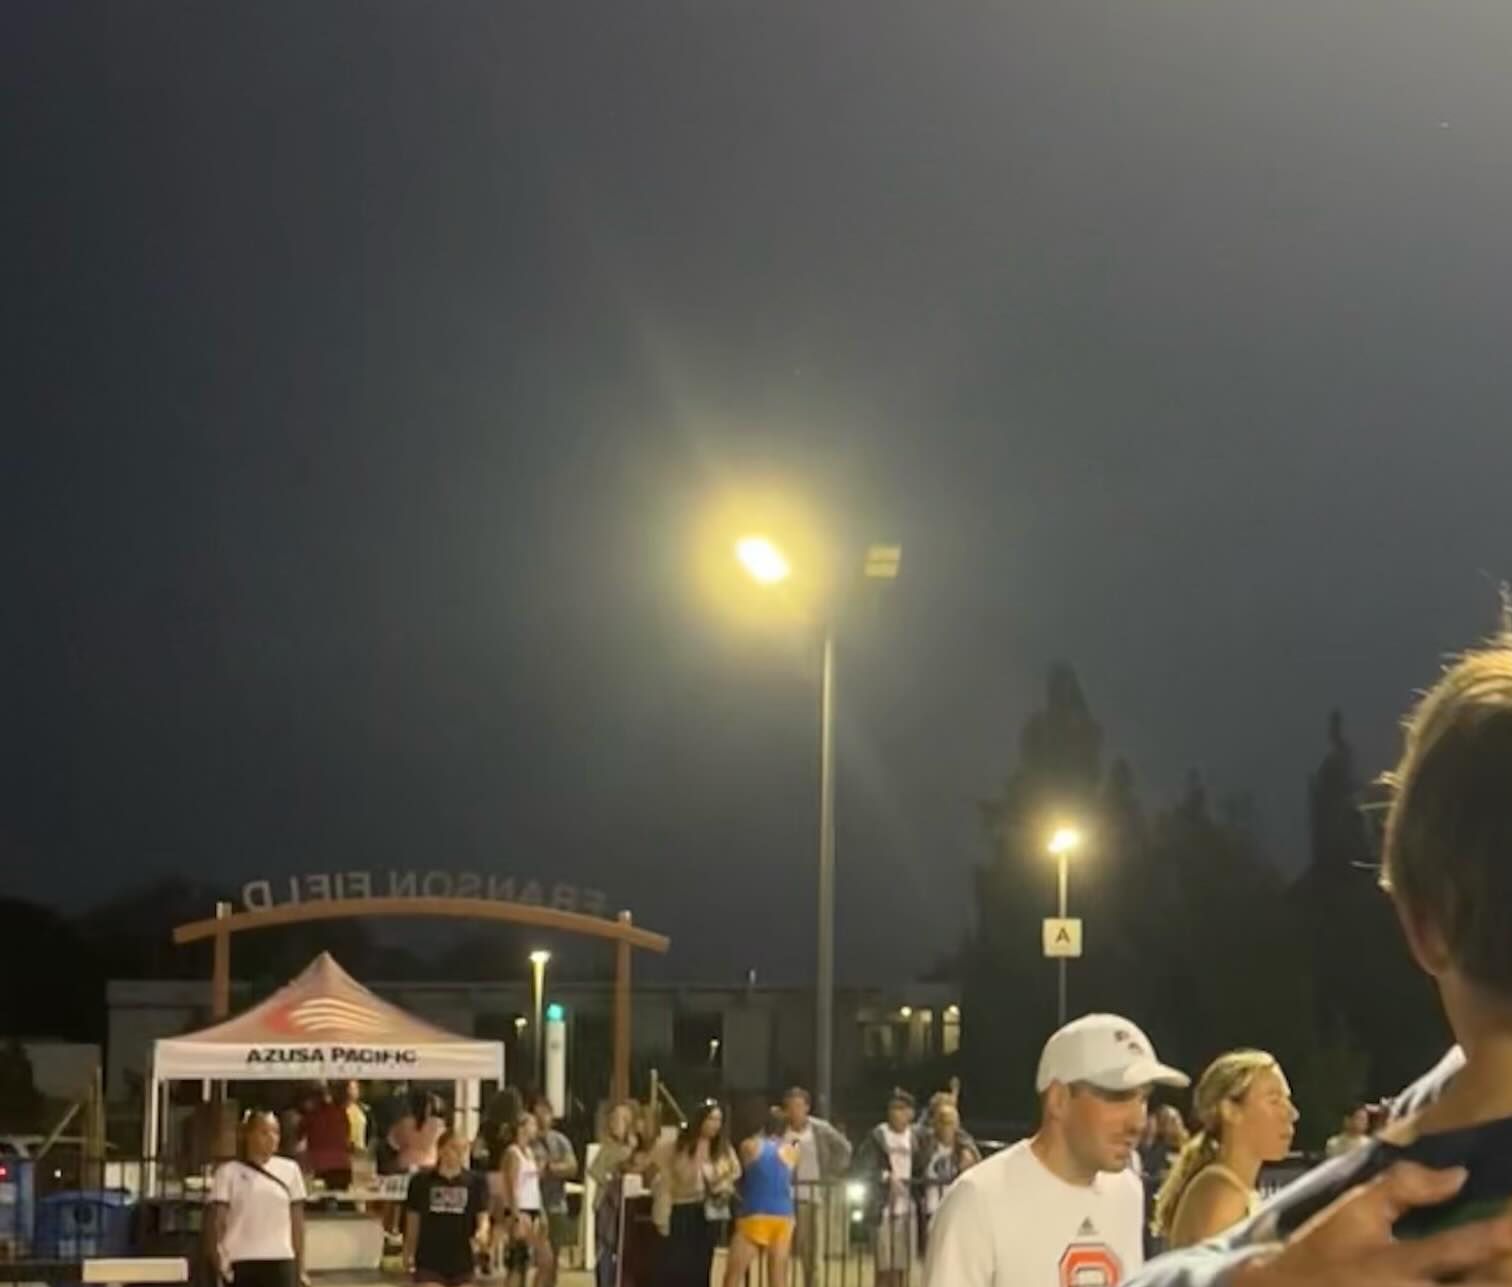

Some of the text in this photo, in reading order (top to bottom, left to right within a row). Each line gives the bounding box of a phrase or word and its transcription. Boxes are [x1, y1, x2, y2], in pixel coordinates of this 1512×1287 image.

[1055, 927, 1071, 944] A
[247, 1047, 417, 1064] AZUSA PACIFIC
